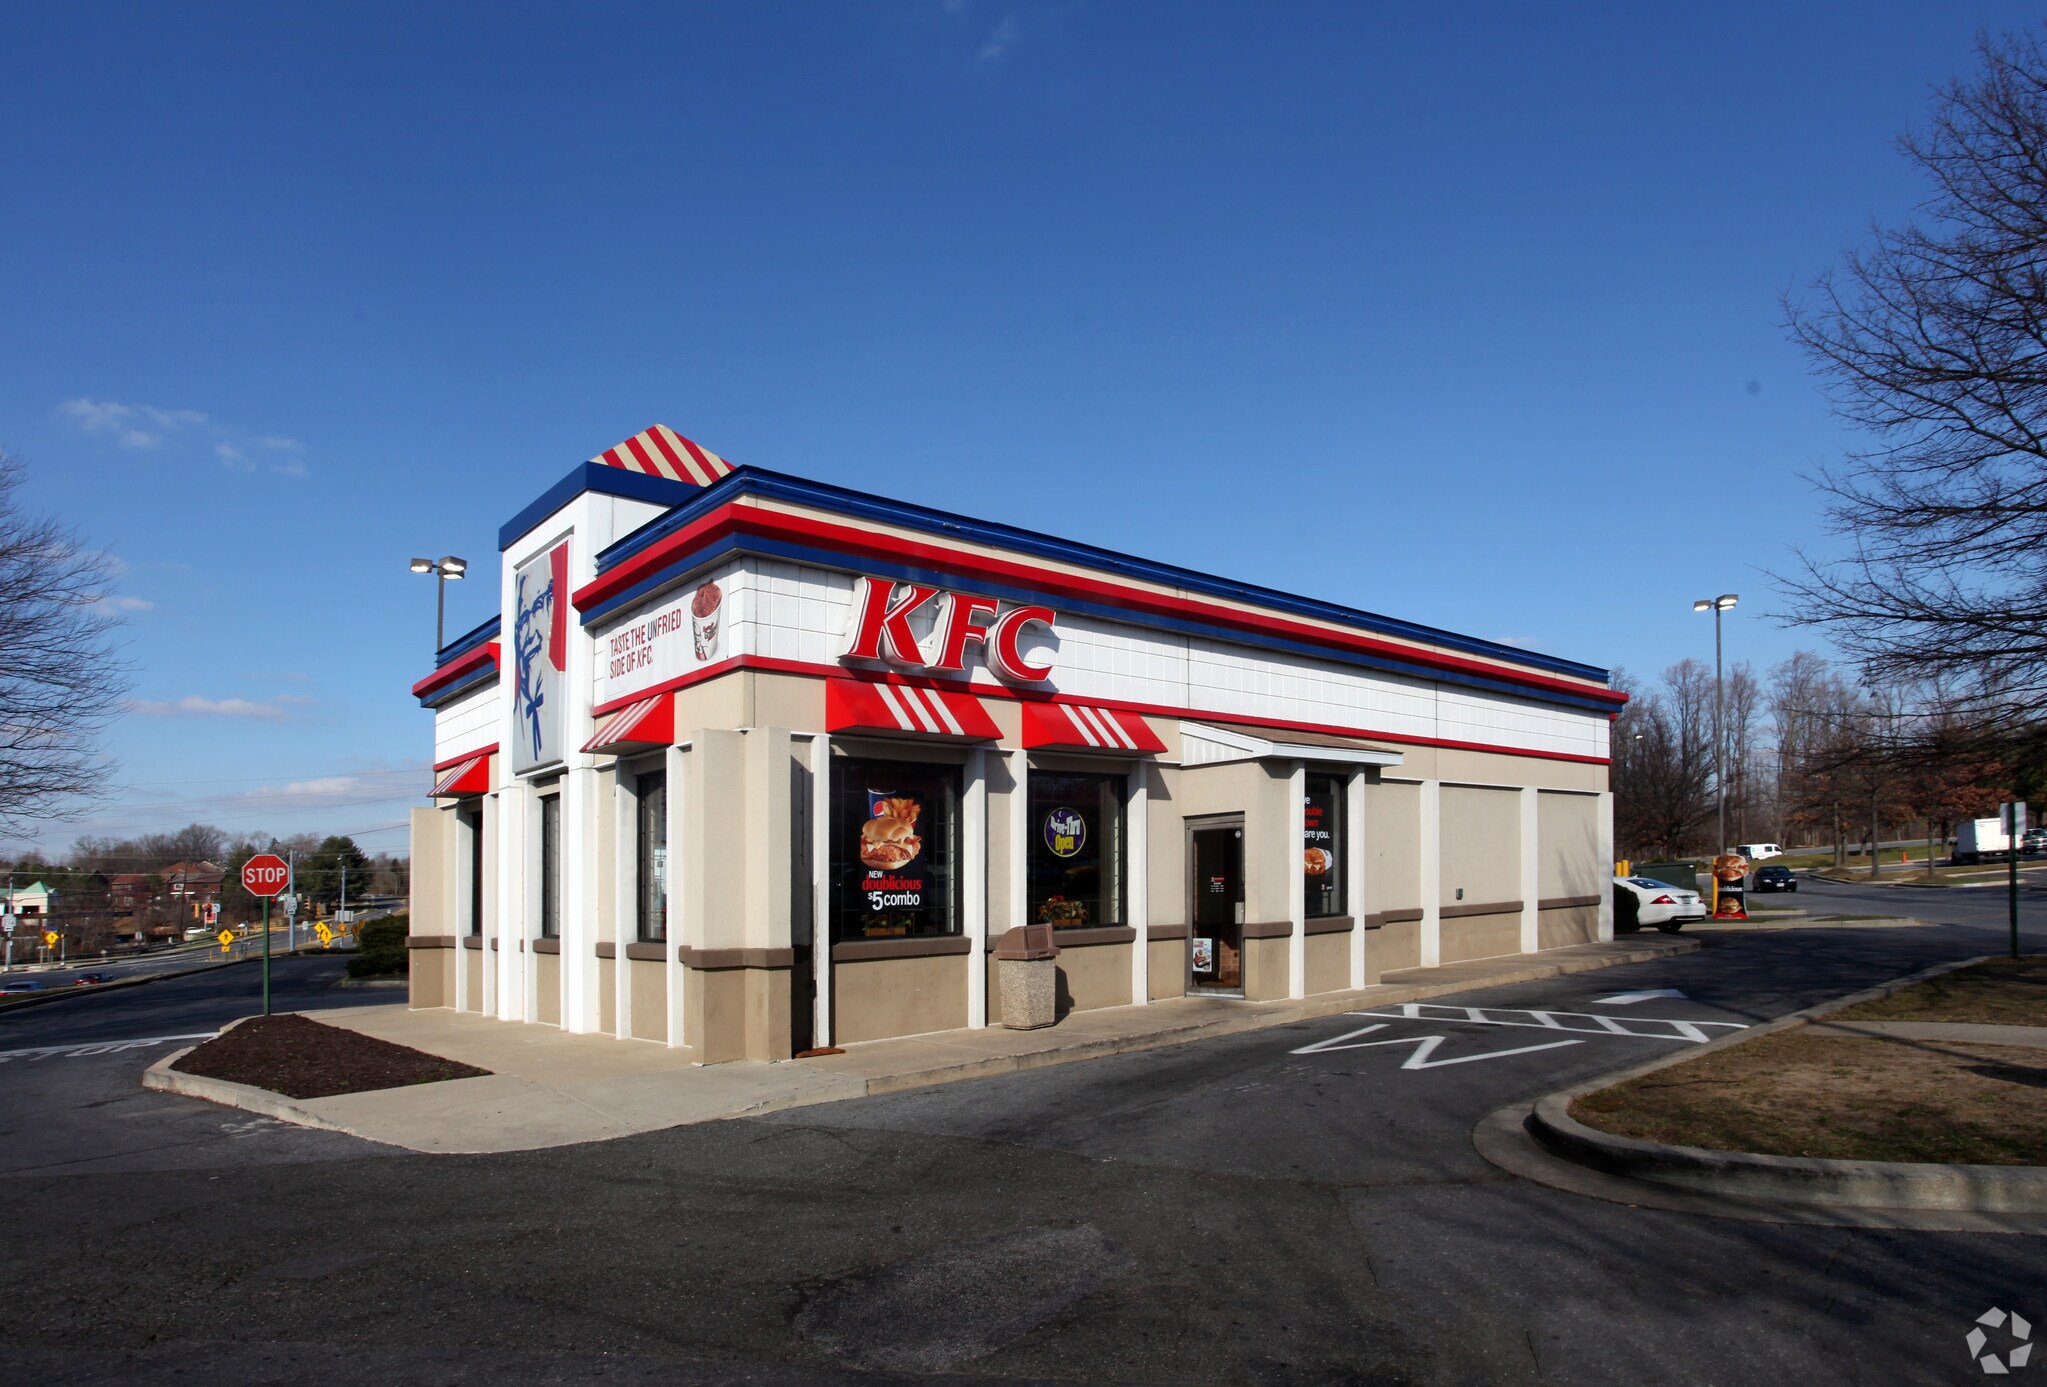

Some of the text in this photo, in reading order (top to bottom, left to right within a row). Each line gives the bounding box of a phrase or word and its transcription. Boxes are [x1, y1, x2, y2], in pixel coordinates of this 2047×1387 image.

[610, 631, 630, 657] TASTE
[631, 624, 646, 648] THE
[647, 608, 682, 641] UNFRIED
[840, 577, 1056, 682] KFC
[610, 656, 625, 680] SIDE
[626, 652, 636, 673] OF
[1055, 834, 1074, 854] Open
[246, 868, 286, 883] STOP
[862, 875, 922, 891] doublicious
[868, 870, 883, 879] NEW
[884, 891, 920, 906] combo
